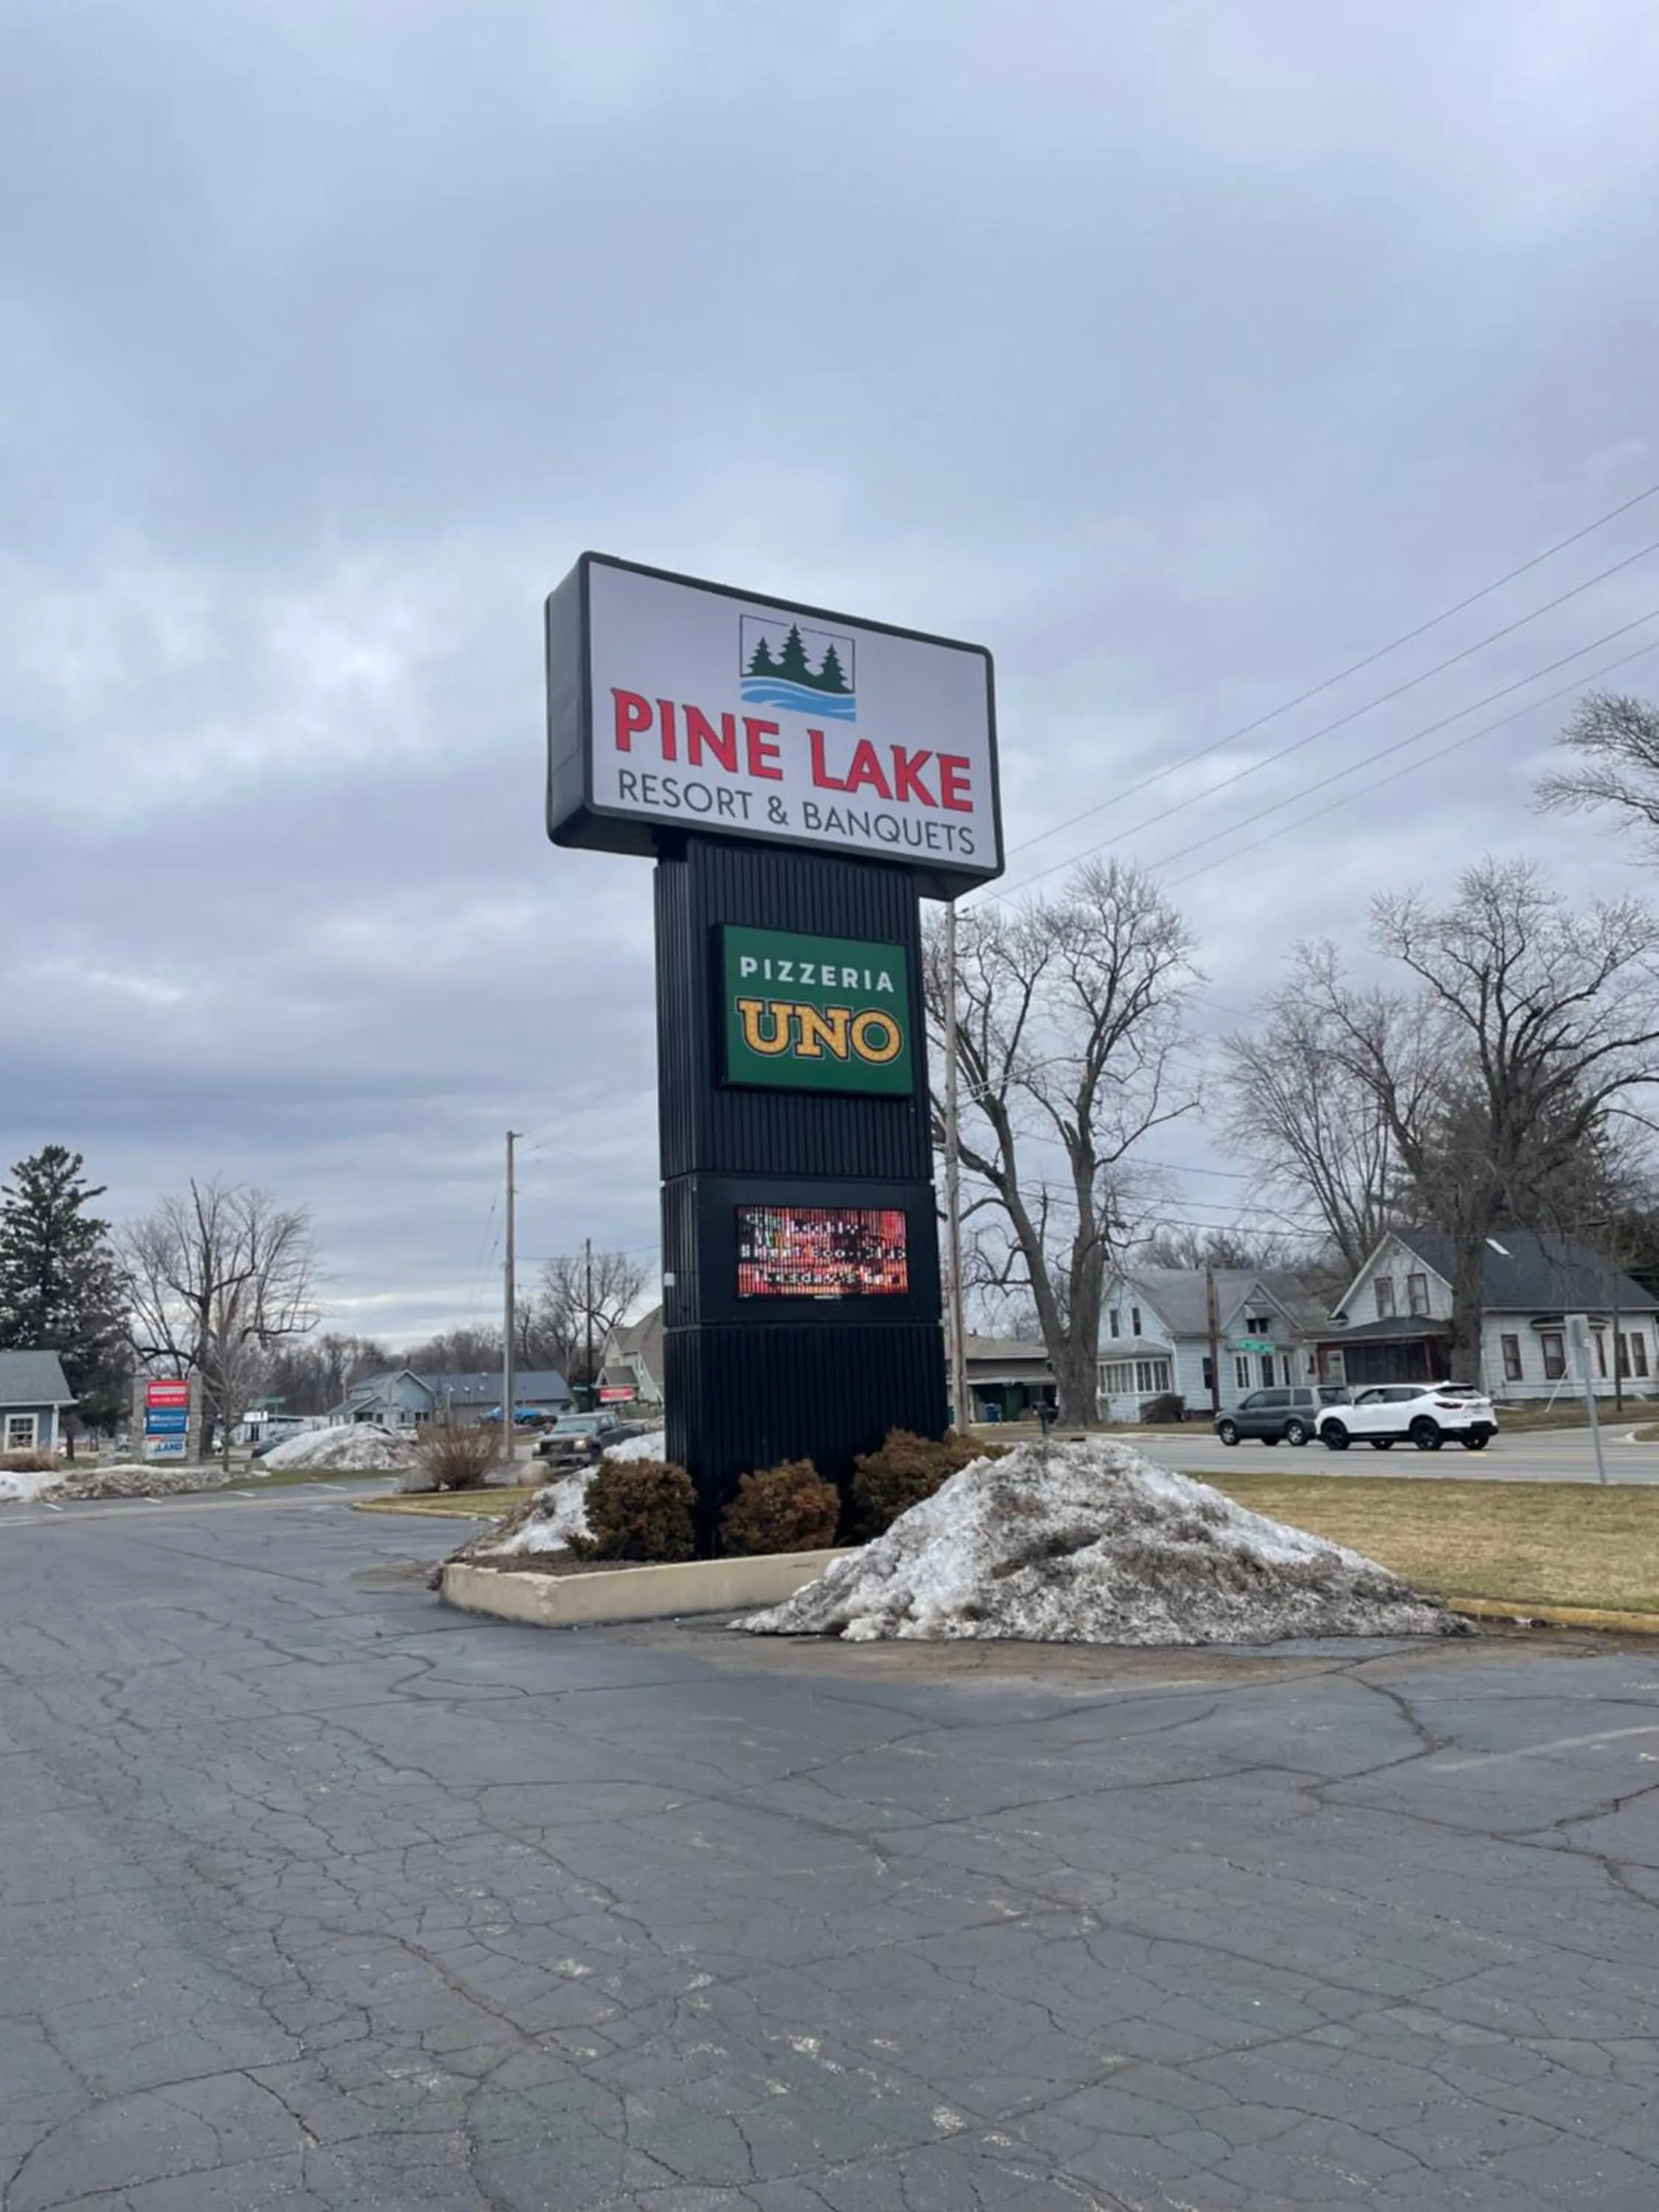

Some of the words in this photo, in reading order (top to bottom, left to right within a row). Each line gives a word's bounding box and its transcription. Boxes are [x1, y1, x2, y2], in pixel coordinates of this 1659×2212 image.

[611, 686, 783, 780] PINE
[807, 728, 973, 812] LAKE
[618, 768, 752, 820] RESORT
[768, 796, 789, 826] &
[802, 801, 975, 855] BANQUETS
[740, 956, 894, 992] PIZZERIA
[736, 996, 904, 1065] UNO
